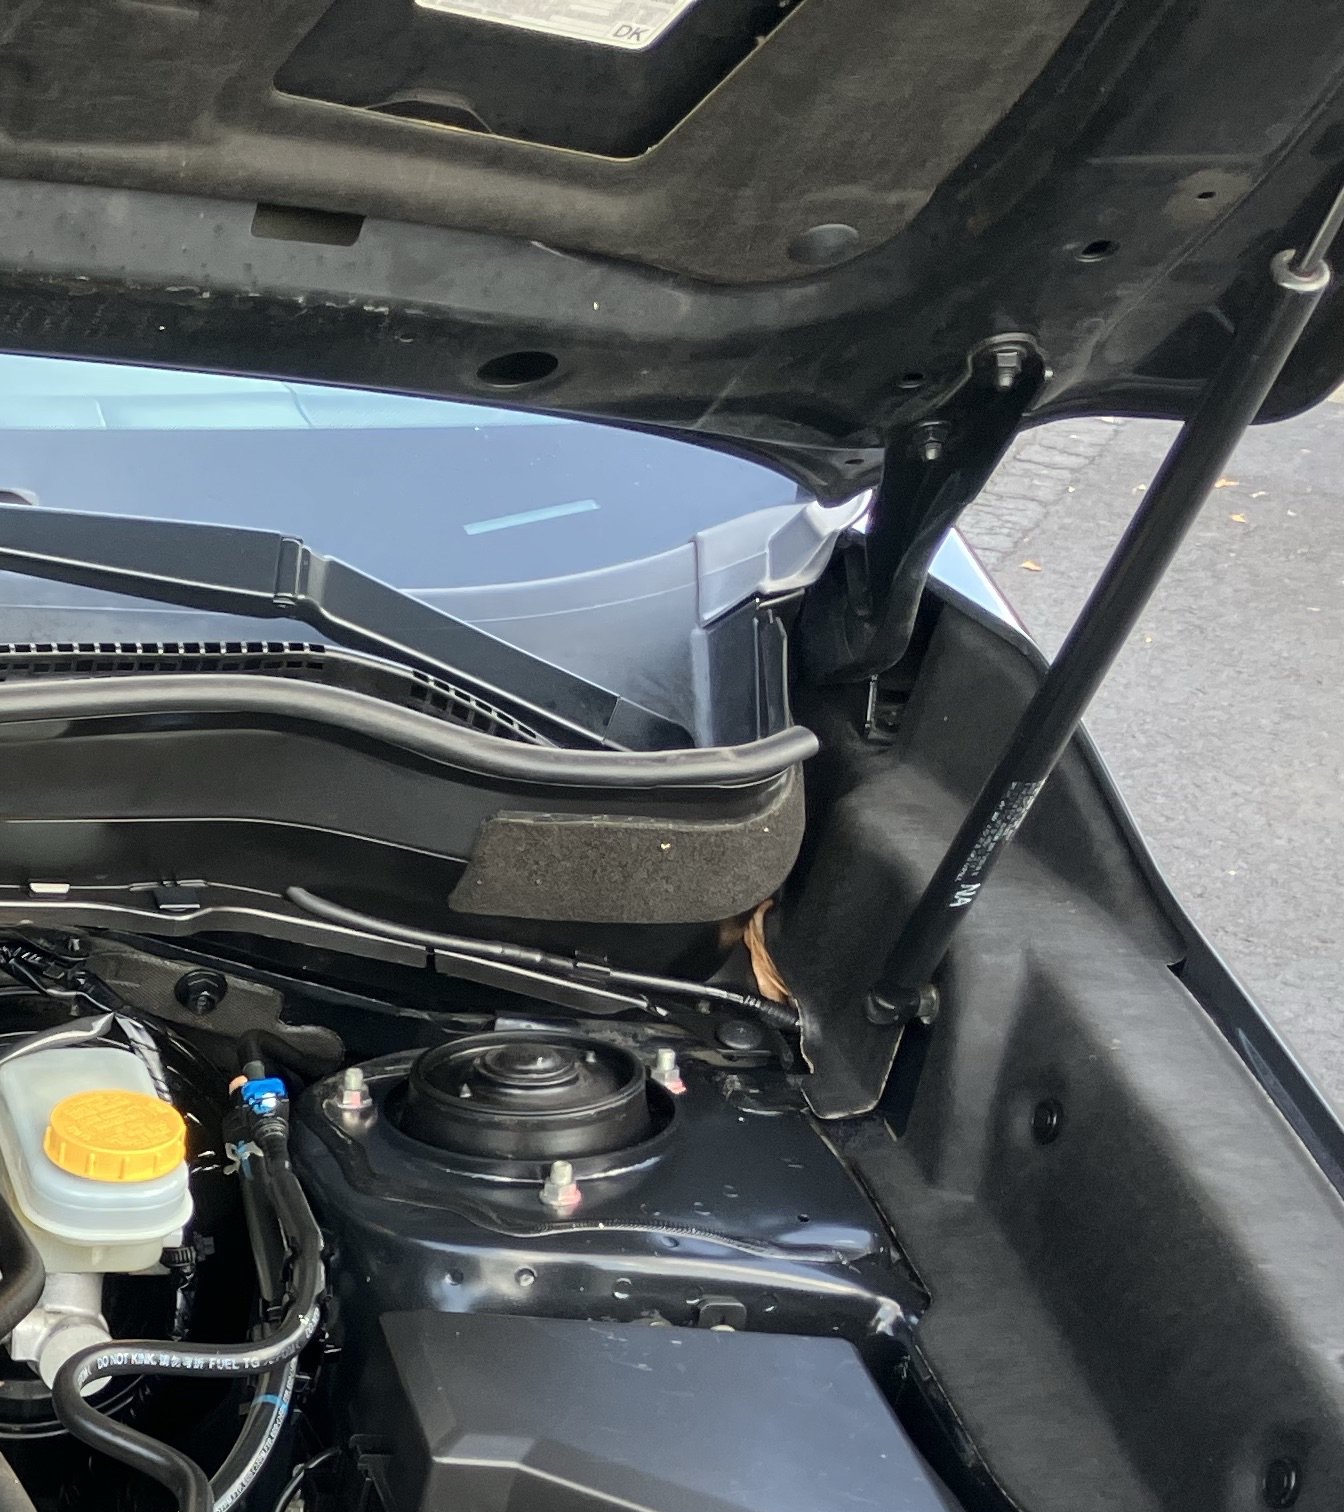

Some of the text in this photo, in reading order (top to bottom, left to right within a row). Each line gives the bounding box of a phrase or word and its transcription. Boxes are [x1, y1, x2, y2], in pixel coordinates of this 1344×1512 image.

[612, 24, 650, 42] DK
[109, 1353, 127, 1365] NOT
[208, 1357, 239, 1371] FUEL
